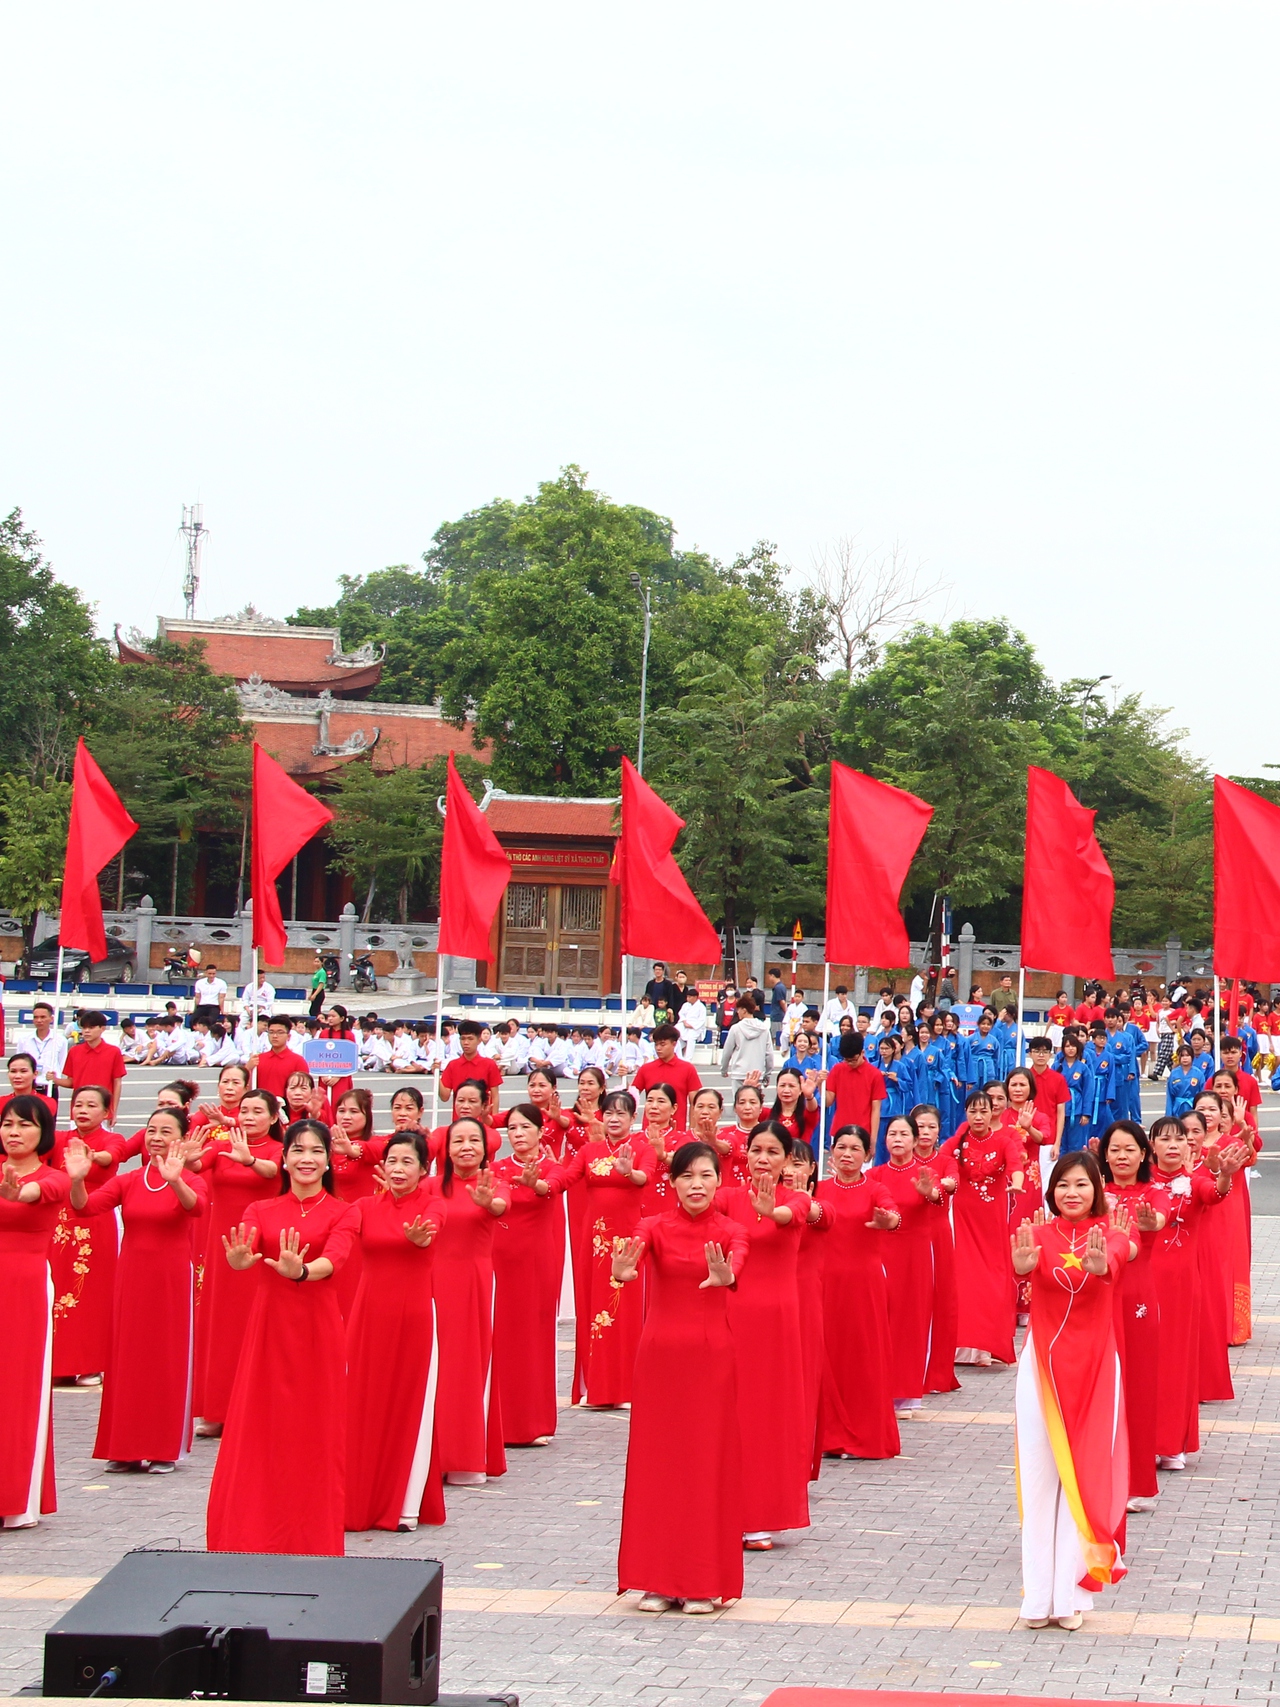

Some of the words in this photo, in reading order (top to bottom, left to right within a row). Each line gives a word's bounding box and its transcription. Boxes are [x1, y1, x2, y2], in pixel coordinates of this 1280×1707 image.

[512, 852, 522, 861] THỜ
[522, 852, 532, 862] CÁC
[532, 854, 542, 862] ANH
[542, 853, 554, 862] HÙNG
